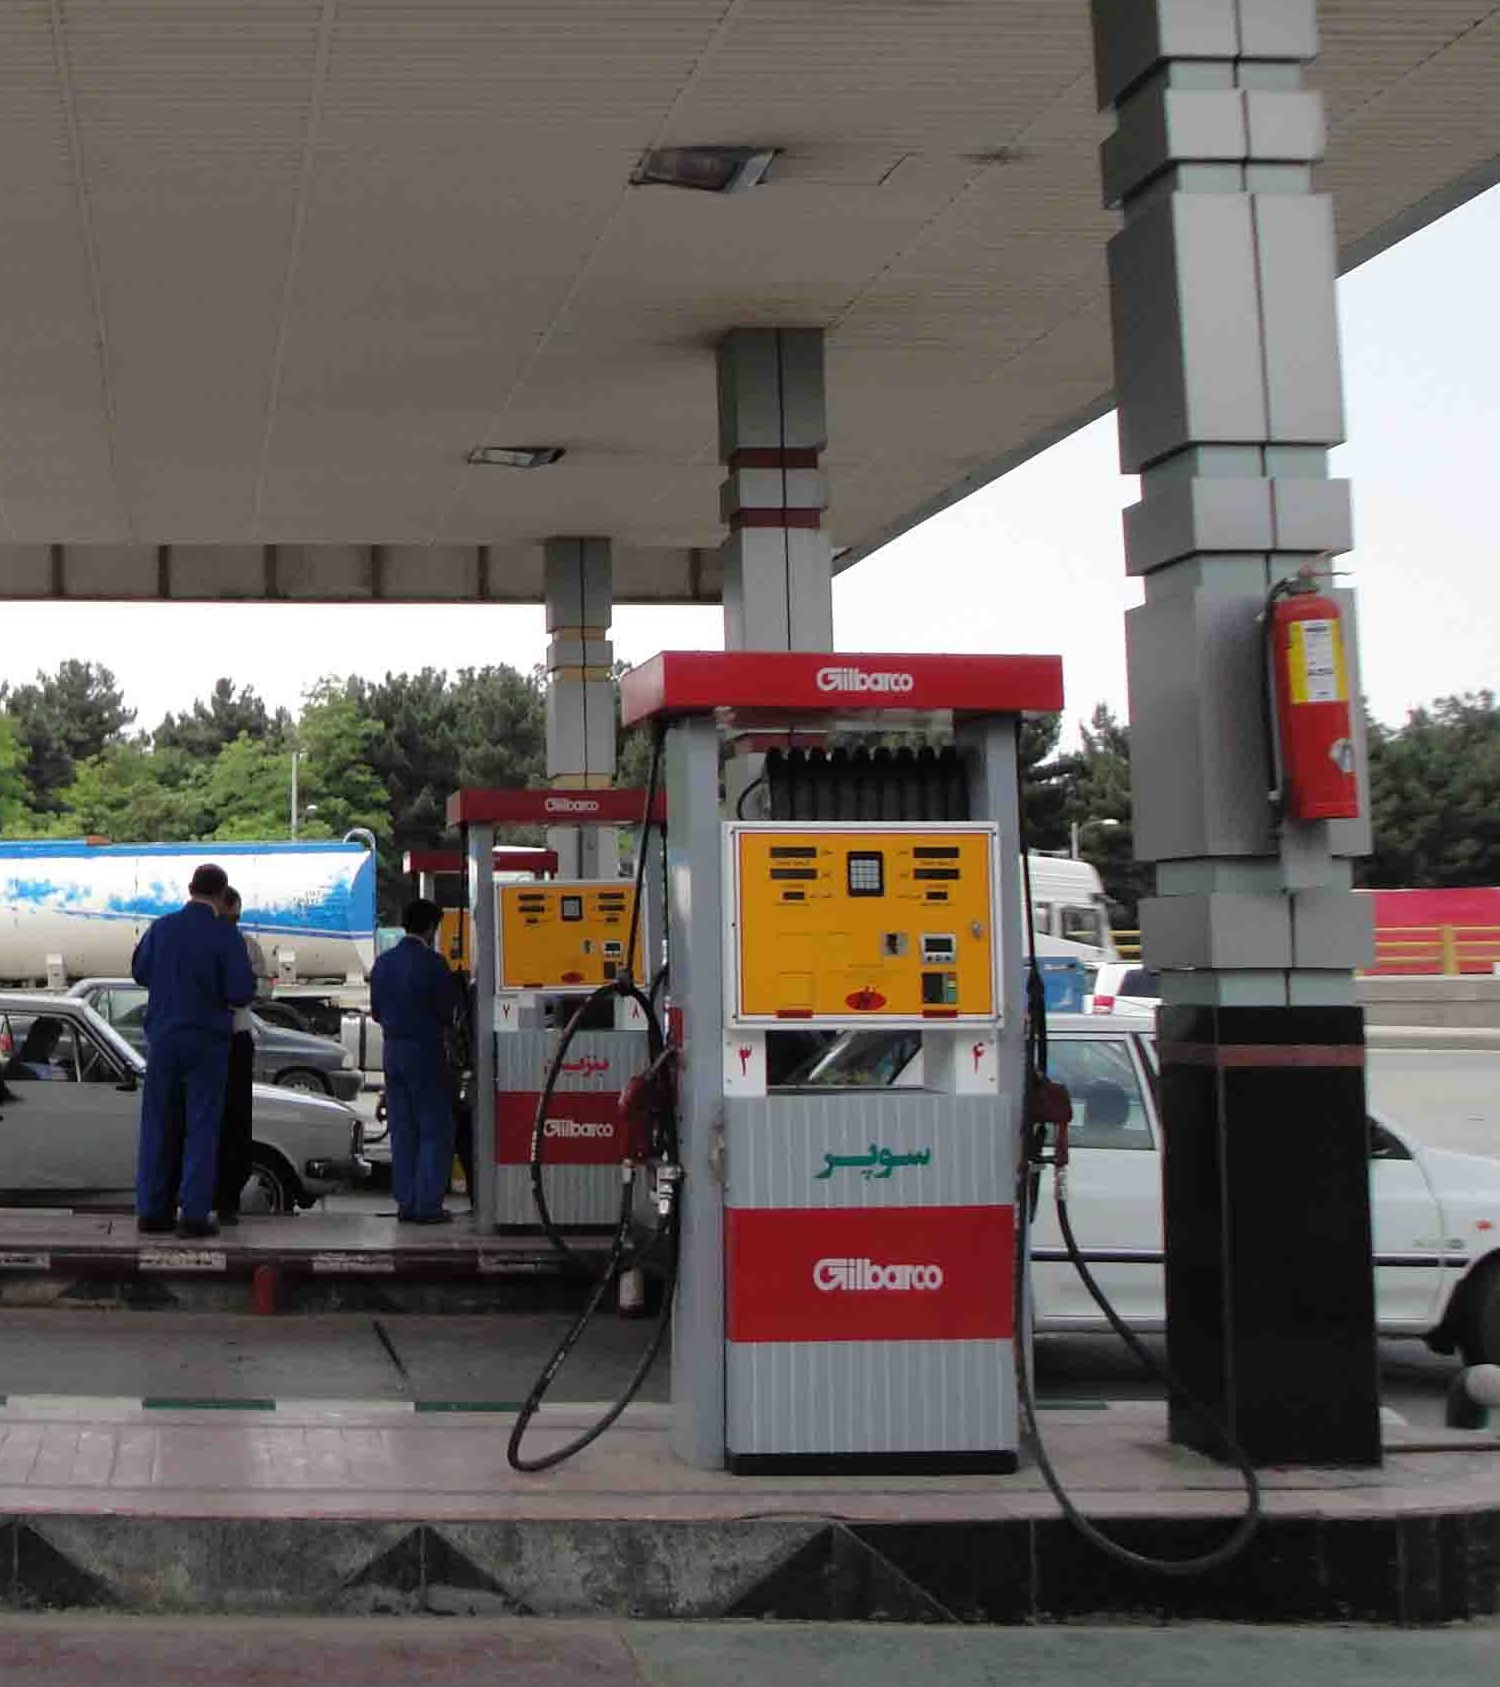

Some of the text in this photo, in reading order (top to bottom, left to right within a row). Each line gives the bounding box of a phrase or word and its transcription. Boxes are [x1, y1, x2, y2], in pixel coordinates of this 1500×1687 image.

[817, 667, 913, 691] Gilbarco
[545, 798, 599, 812] Gilbarco
[543, 1118, 613, 1138] Gilbarco
[813, 1143, 932, 1182] سوپر
[813, 1258, 944, 1291] Gilbarco
